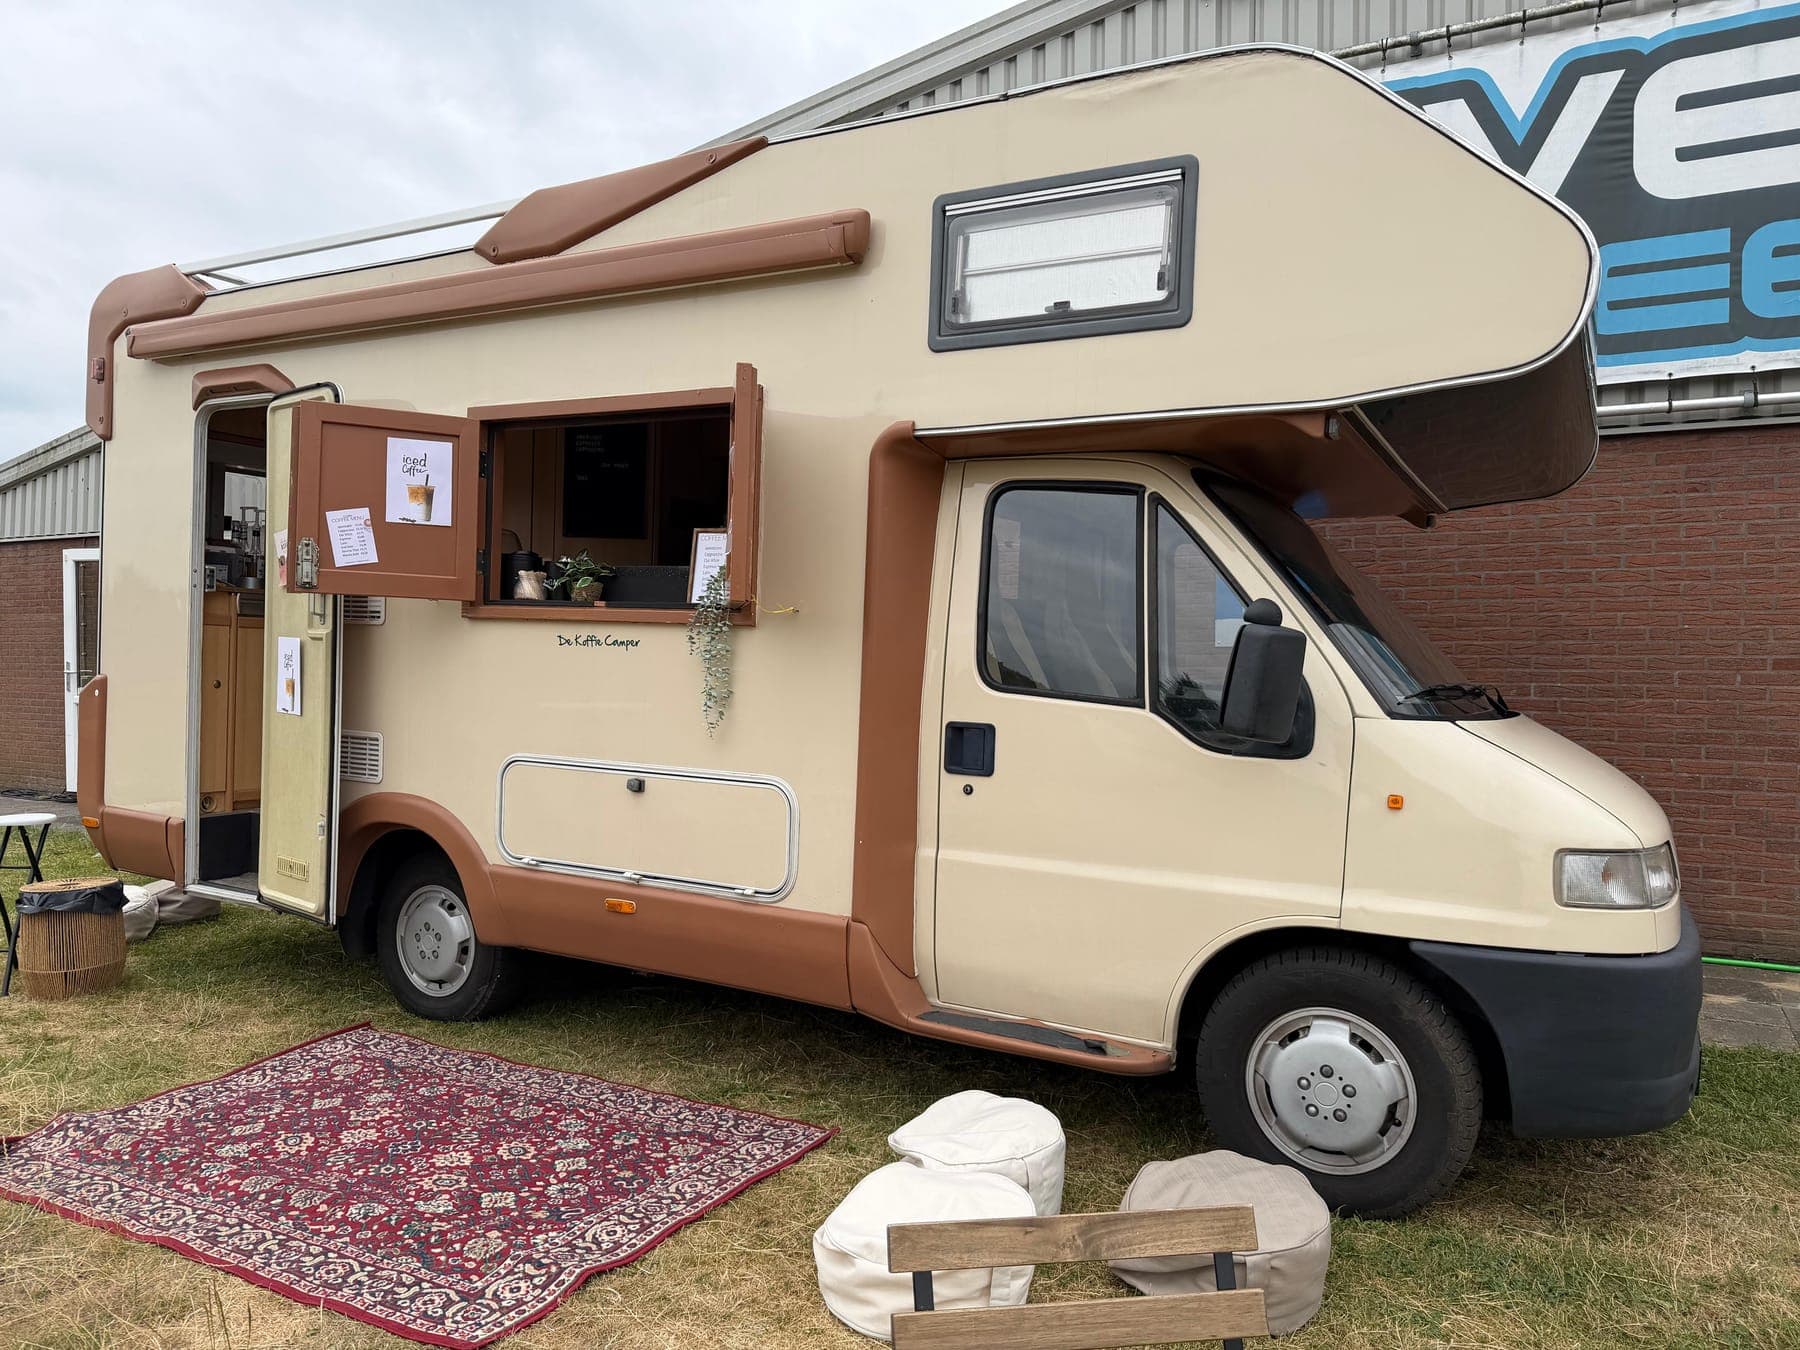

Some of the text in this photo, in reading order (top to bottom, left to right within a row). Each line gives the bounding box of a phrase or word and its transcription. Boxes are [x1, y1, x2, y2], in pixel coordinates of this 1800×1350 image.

[403, 452, 427, 468] iced
[557, 634, 641, 651] De Koffie Camper
